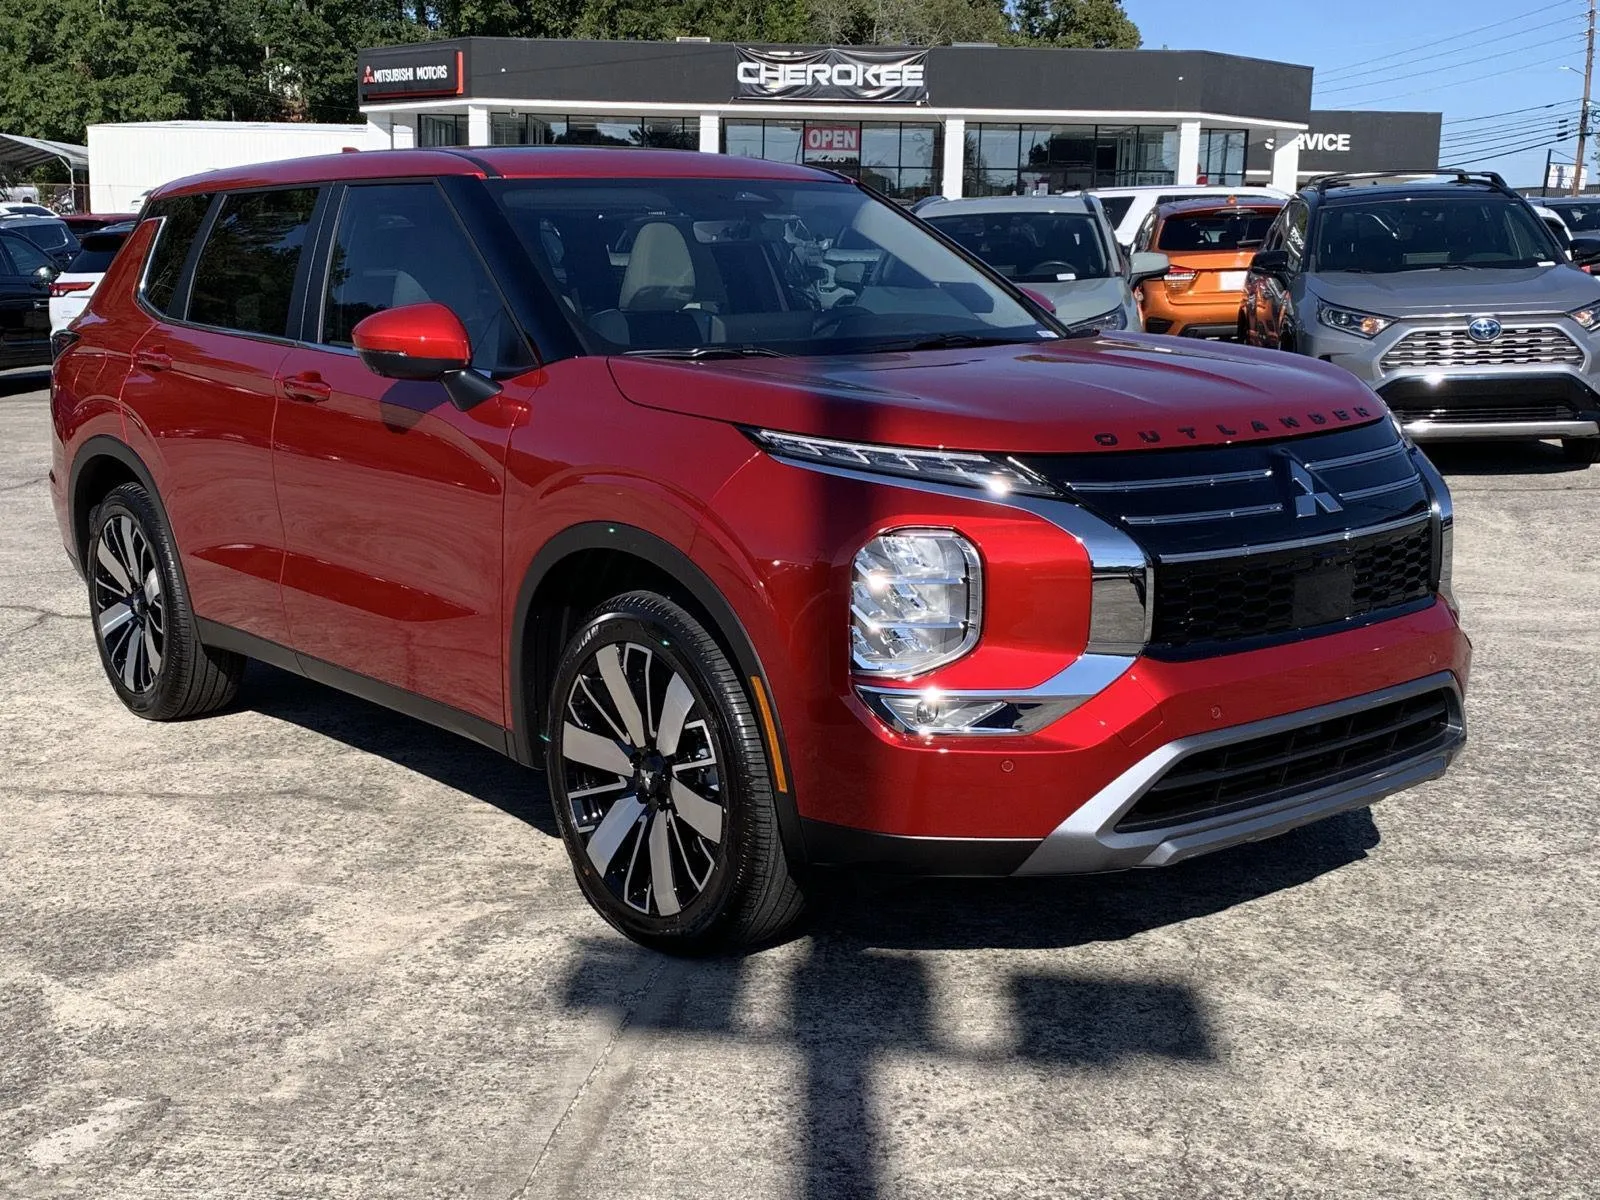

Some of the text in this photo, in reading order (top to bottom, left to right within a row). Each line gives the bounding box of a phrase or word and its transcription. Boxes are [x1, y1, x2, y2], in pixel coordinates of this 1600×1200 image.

[374, 65, 448, 83] MITSUBISHI MOTORS
[737, 62, 925, 87] CHEROKEE
[808, 129, 857, 148] OPEN
[1264, 133, 1351, 151] SRVICE
[1094, 406, 1371, 447] OUTLANDER
